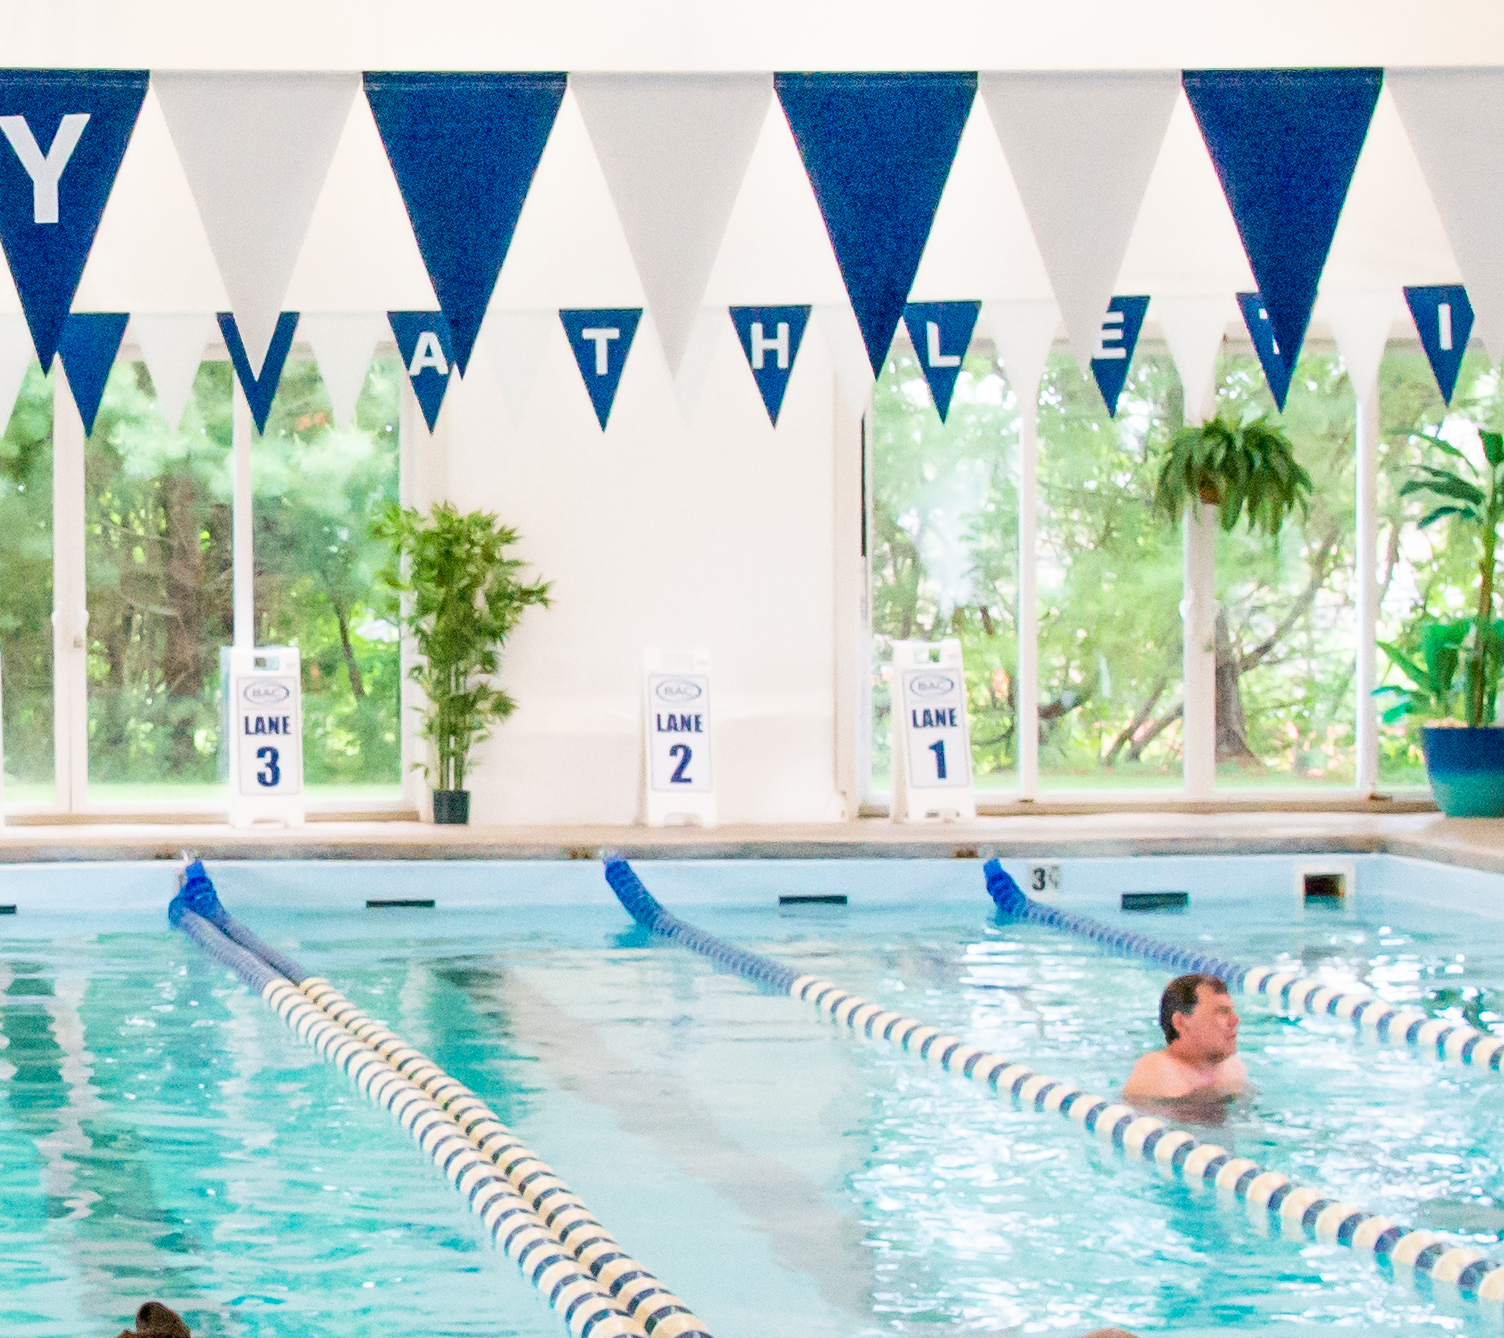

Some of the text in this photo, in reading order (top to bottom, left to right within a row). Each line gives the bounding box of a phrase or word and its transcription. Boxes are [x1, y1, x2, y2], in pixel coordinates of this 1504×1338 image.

[244, 715, 292, 736] LANE
[656, 713, 703, 733] LANE
[912, 708, 958, 728] LANE
[256, 746, 281, 787] 3
[669, 743, 693, 784] 2
[929, 739, 947, 779] 1
[1032, 867, 1046, 892] 3
